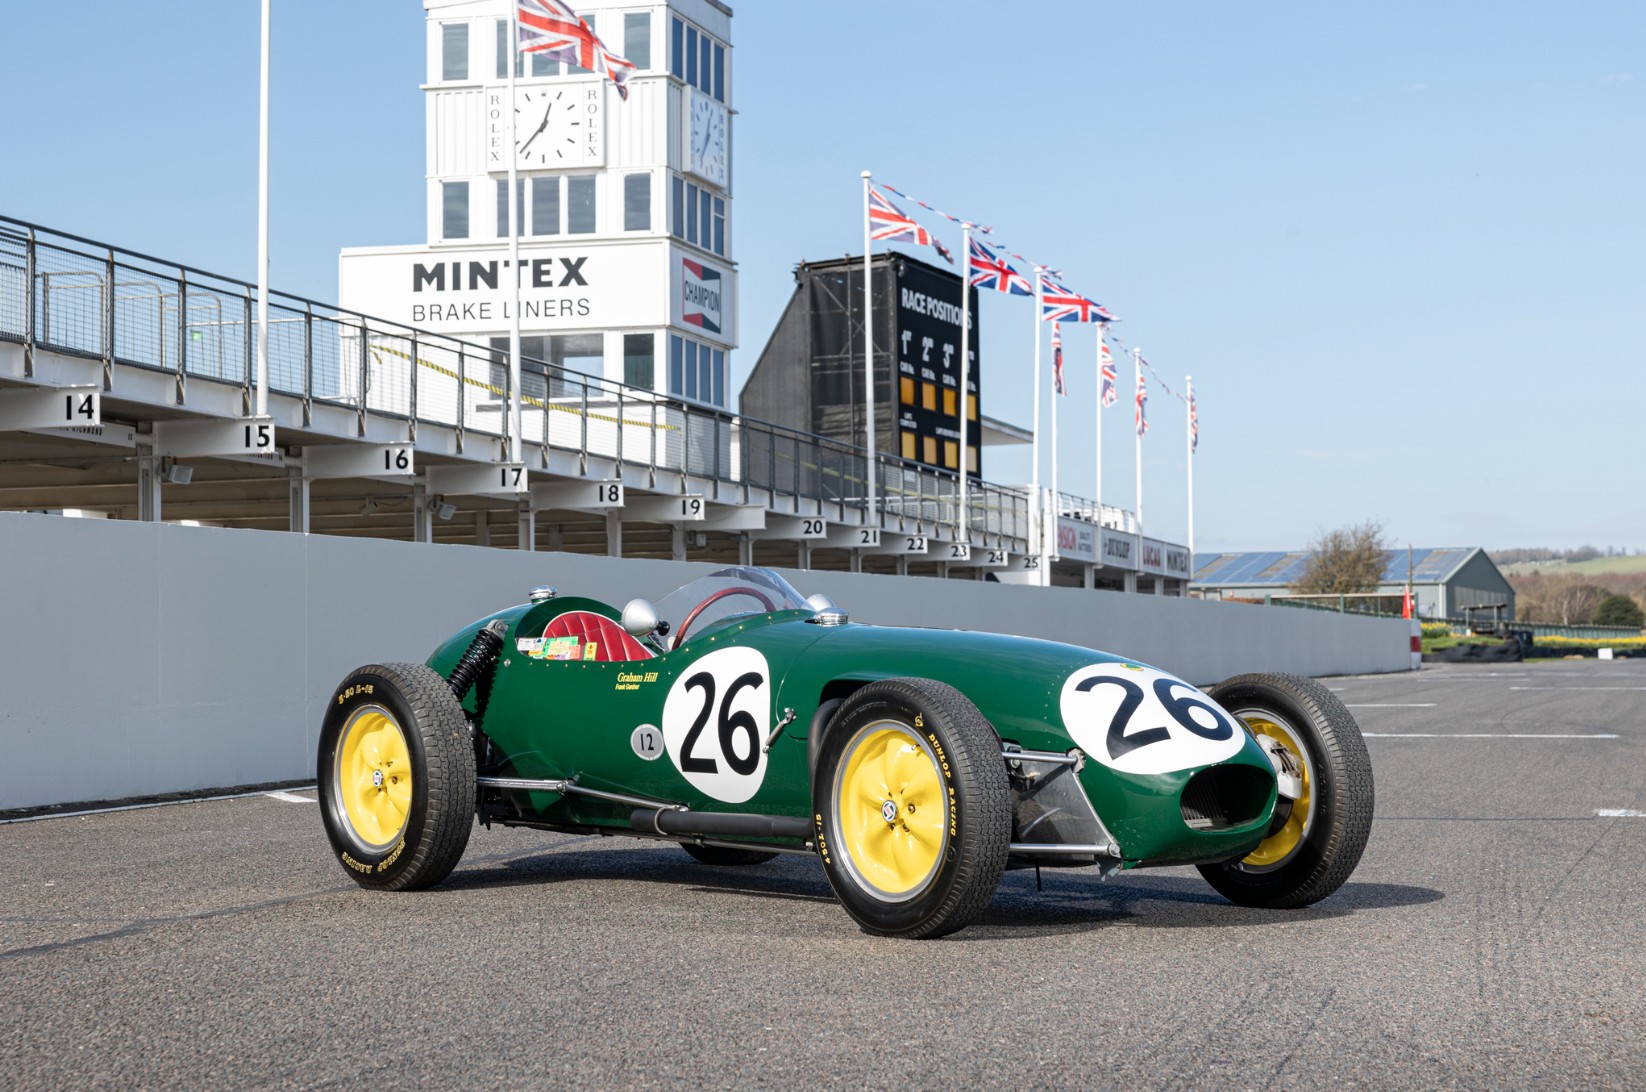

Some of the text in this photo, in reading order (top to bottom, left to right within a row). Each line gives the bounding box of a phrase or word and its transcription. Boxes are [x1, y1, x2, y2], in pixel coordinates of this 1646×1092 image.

[490, 95, 500, 161] ROLEX
[587, 90, 597, 156] ROLEX
[413, 256, 589, 292] MINTEX
[685, 280, 720, 312] CHAMPION
[902, 287, 926, 315] RACE
[413, 298, 590, 322] BRAKE LINERS
[66, 394, 94, 420] 14
[245, 425, 270, 448] 15
[385, 449, 409, 470] 16
[501, 468, 522, 487] 17
[599, 484, 619, 502] 18
[682, 499, 700, 515] 19
[803, 520, 823, 535] 20
[861, 530, 877, 543] 21
[907, 538, 924, 550] 22
[951, 545, 967, 557] 23
[988, 551, 1003, 563] 24
[1024, 558, 1038, 568] 25
[617, 672, 659, 682] Graham Hill
[680, 671, 764, 776] 26
[1074, 675, 1234, 761] 26
[640, 733, 655, 751] 12
[928, 733, 957, 836] DUNLOP RACING
